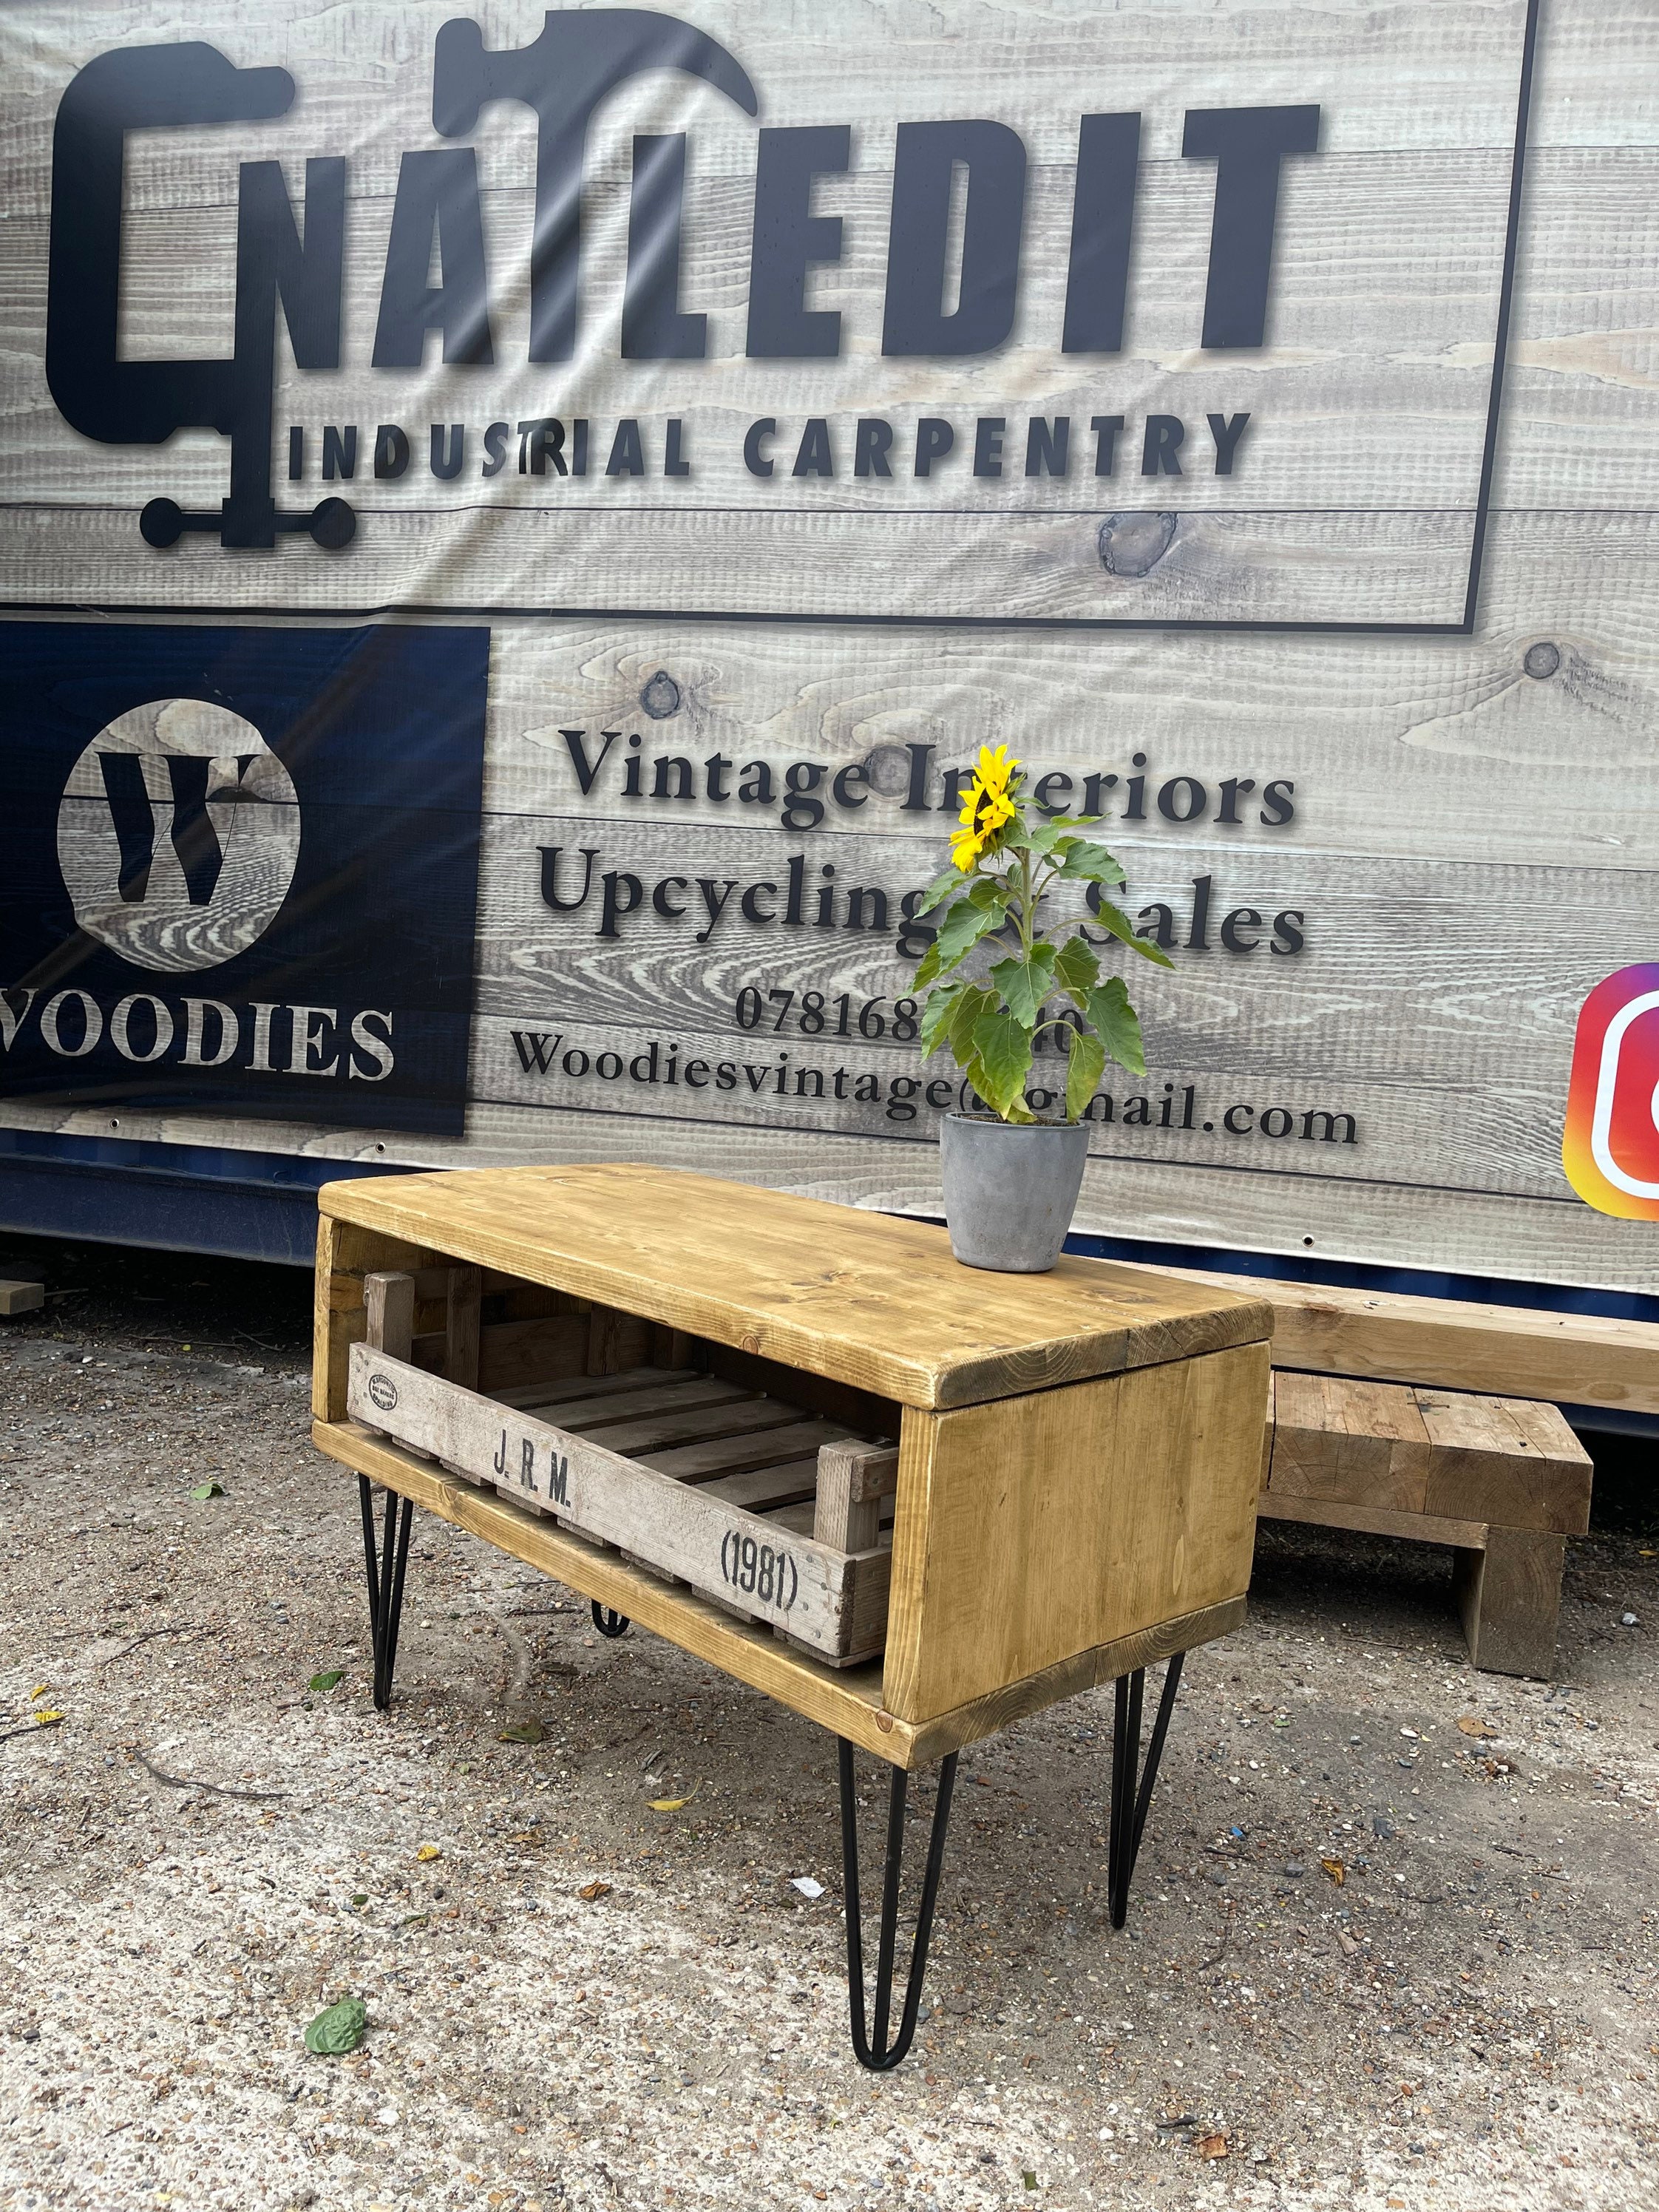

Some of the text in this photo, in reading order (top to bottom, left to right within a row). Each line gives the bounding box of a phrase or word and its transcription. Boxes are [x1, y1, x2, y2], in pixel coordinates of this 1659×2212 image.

[288, 413, 1251, 481] INDUSTRIAL CARPENTRY
[557, 729, 1295, 832] Vintage Ineriors
[94, 751, 262, 906] W
[735, 985, 1084, 1054] 07816840
[721, 1529, 798, 1612] (1981)
